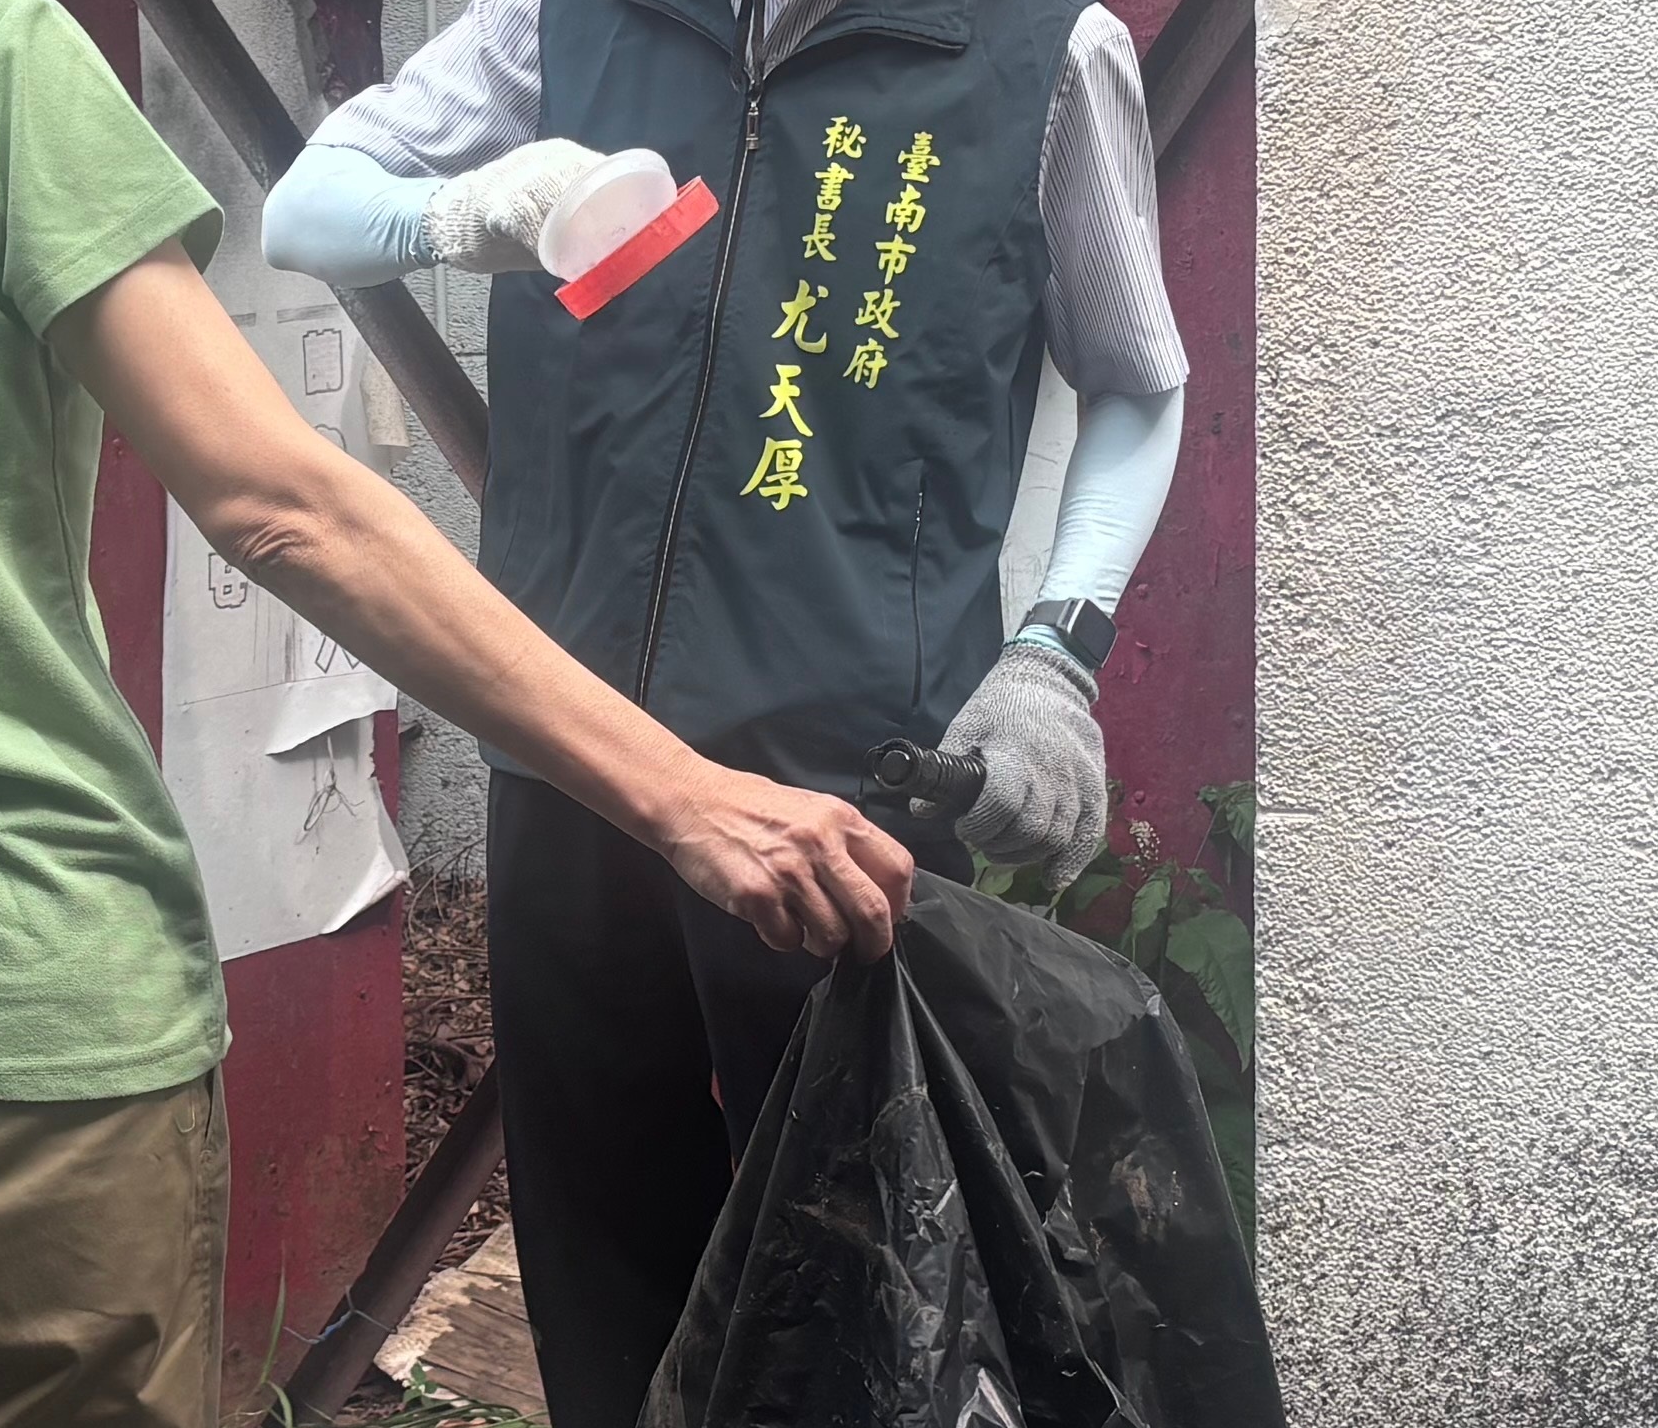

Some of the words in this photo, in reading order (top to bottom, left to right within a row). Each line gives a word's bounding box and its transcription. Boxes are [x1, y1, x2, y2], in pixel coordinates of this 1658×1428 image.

[801, 116, 867, 262] 秘書長
[843, 131, 941, 390] 臺南市政府
[739, 279, 829, 511] 尤天厚
